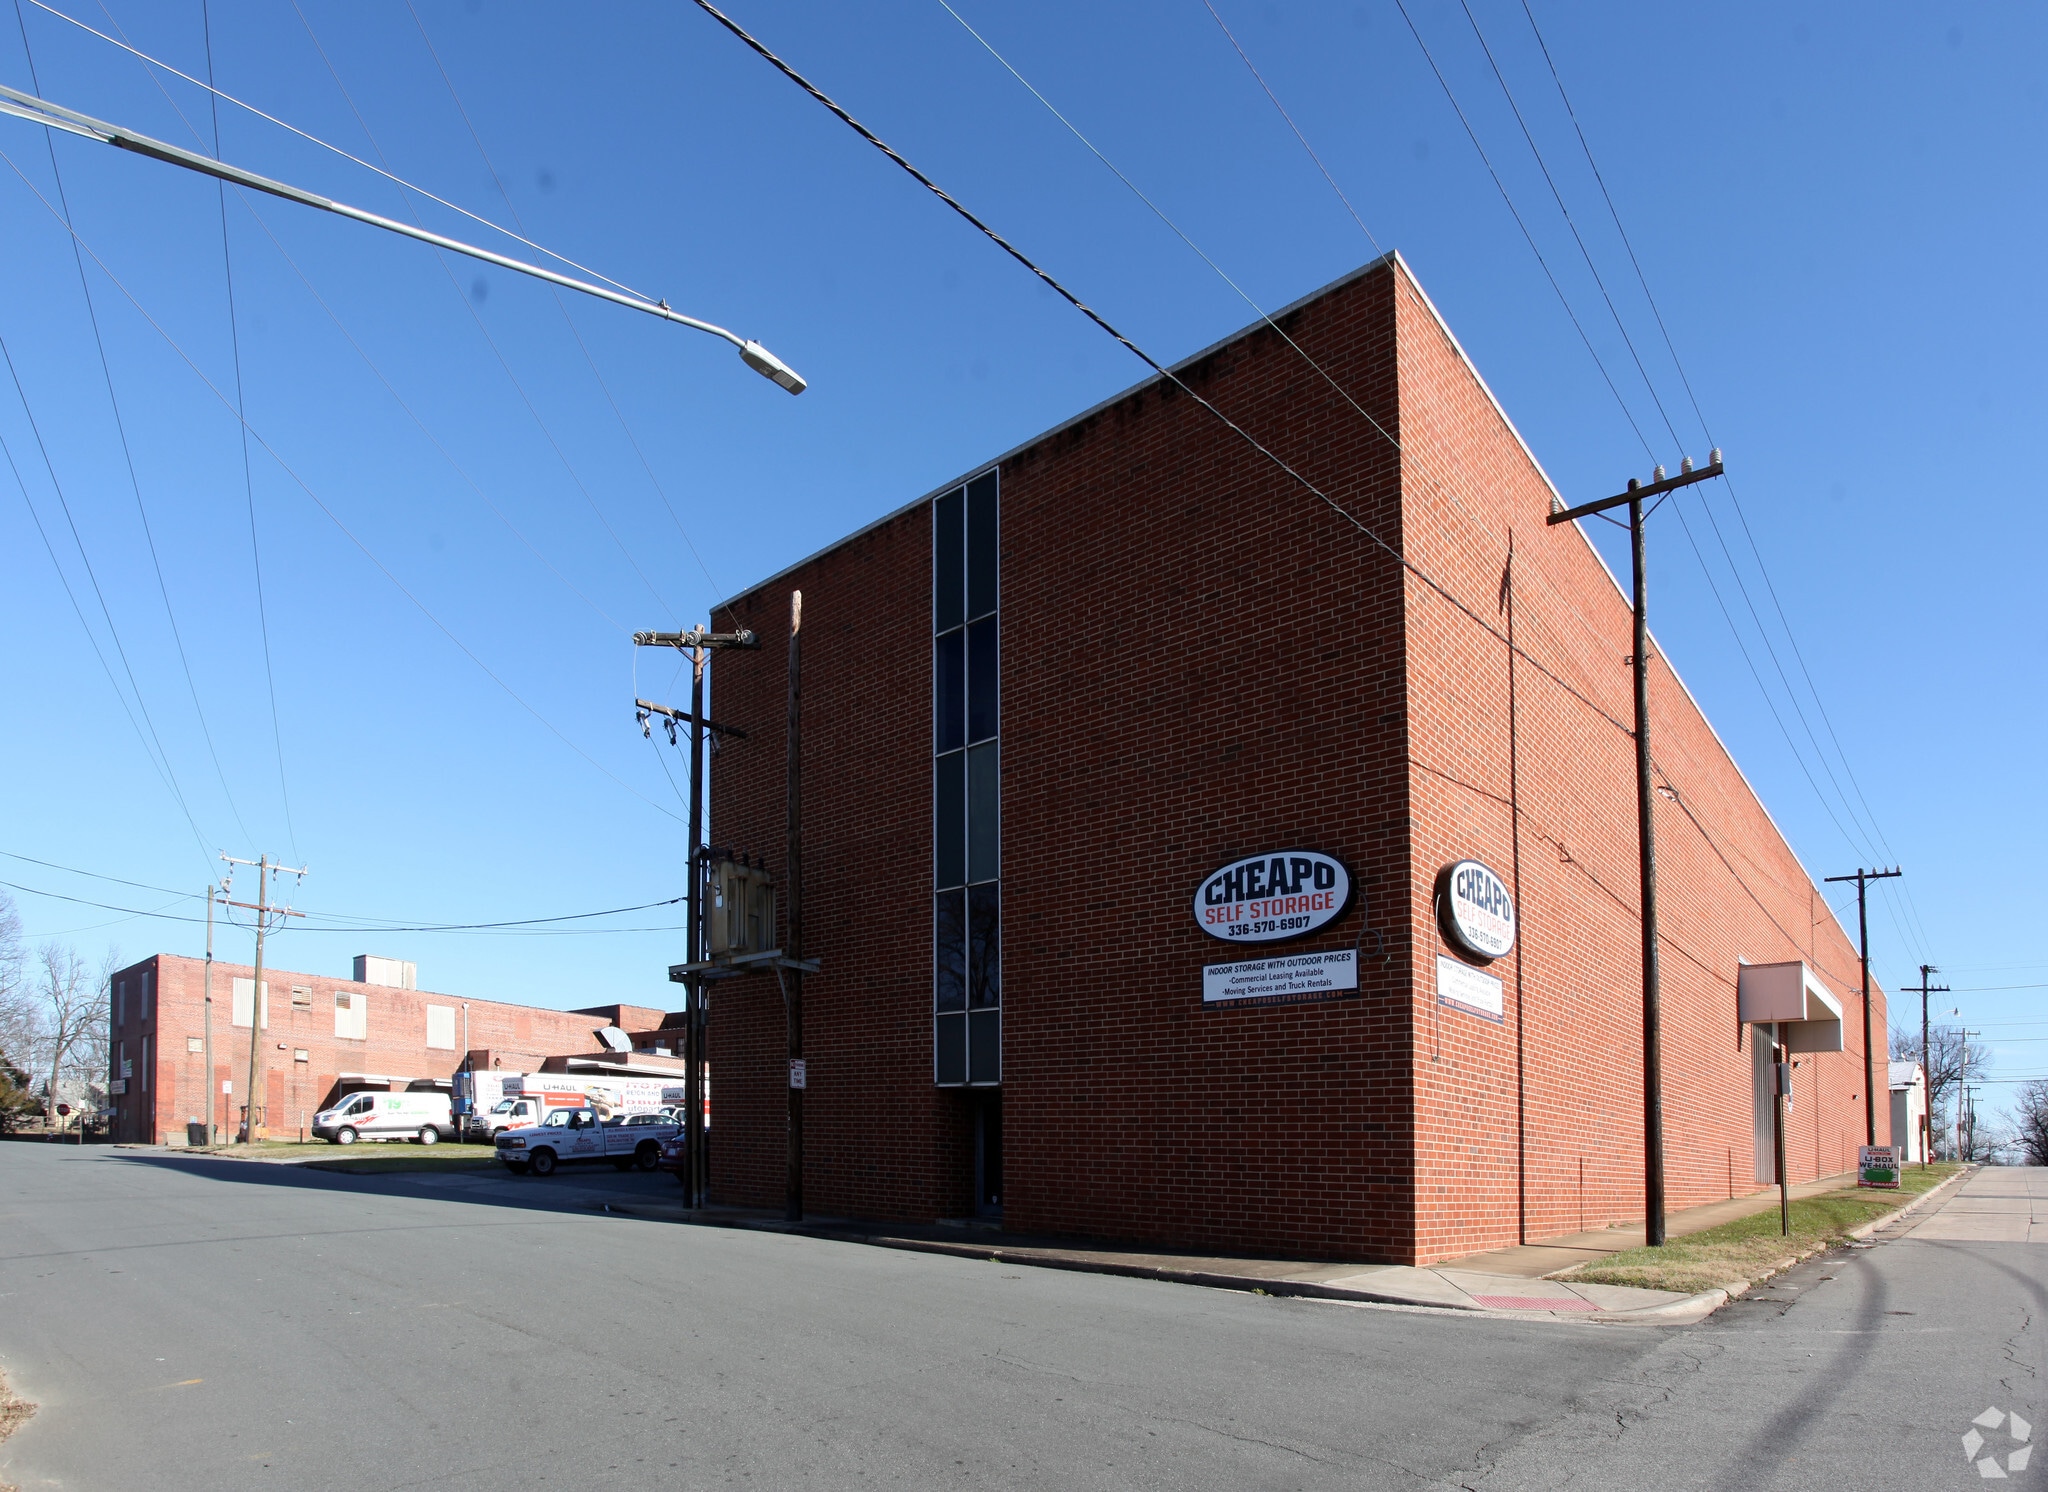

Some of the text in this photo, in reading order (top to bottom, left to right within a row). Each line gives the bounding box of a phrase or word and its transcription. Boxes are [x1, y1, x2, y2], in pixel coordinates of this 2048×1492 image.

[1205, 857, 1335, 906] CHEAPO
[1457, 868, 1510, 922] CHEAPO
[1205, 891, 1334, 925] SELF STORAGE
[1457, 900, 1510, 940] SELF STORAGE
[1228, 915, 1311, 937] 336-570-6907
[1207, 952, 1351, 976] INDOOR STORAGE WITH OUTDOOR PRICES
[1269, 971, 1293, 982] Leasing
[1294, 967, 1324, 978] Available
[1247, 984, 1273, 994] Services
[1274, 982, 1287, 991] and
[1288, 981, 1306, 990] Truck
[1307, 978, 1332, 988] Rentals
